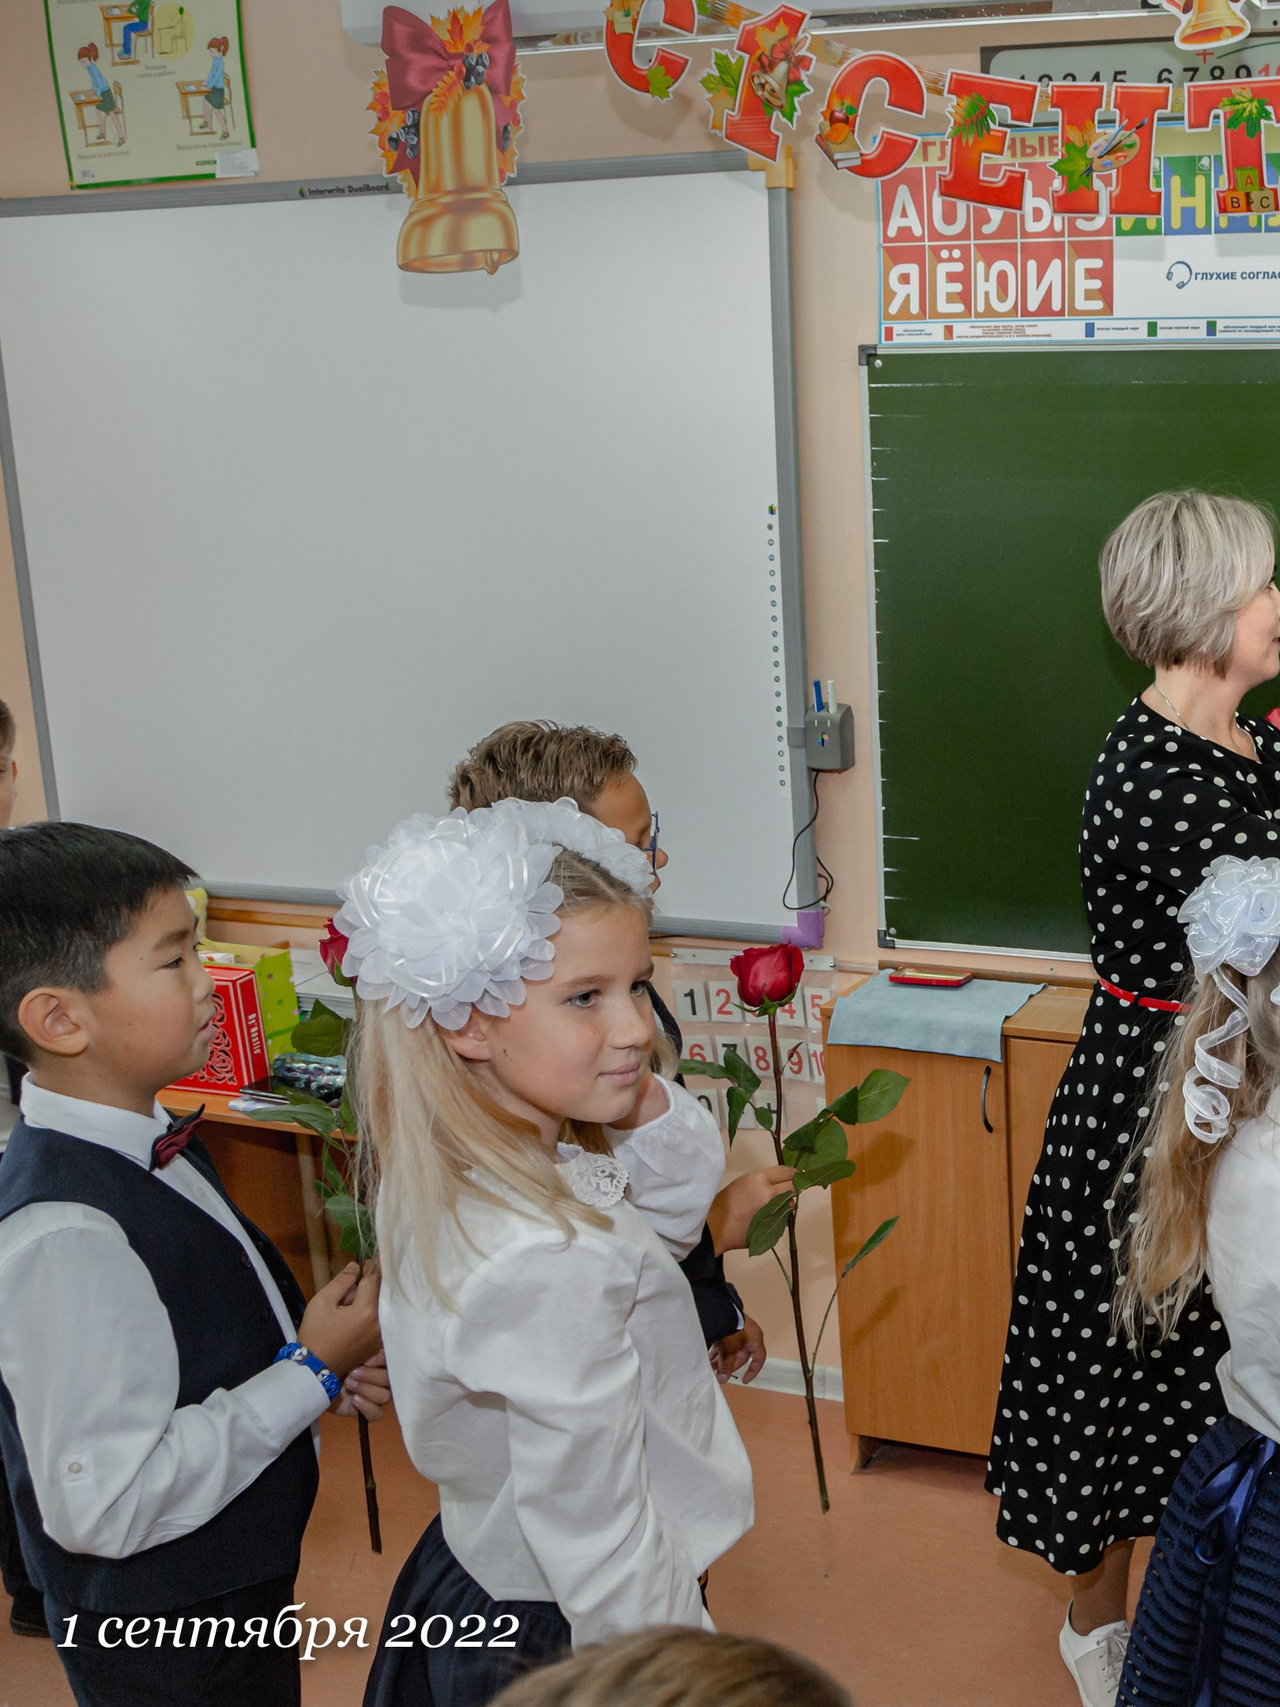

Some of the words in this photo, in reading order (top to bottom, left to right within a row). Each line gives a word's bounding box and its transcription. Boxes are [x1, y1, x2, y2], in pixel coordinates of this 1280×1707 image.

[308, 186, 345, 195] Interwrite
[348, 183, 390, 193] DualBoard
[1194, 271, 1237, 281] ГЛУХИЕ
[684, 988, 697, 1016] 1
[716, 988, 733, 1016] 2
[753, 1046, 771, 1072] 8
